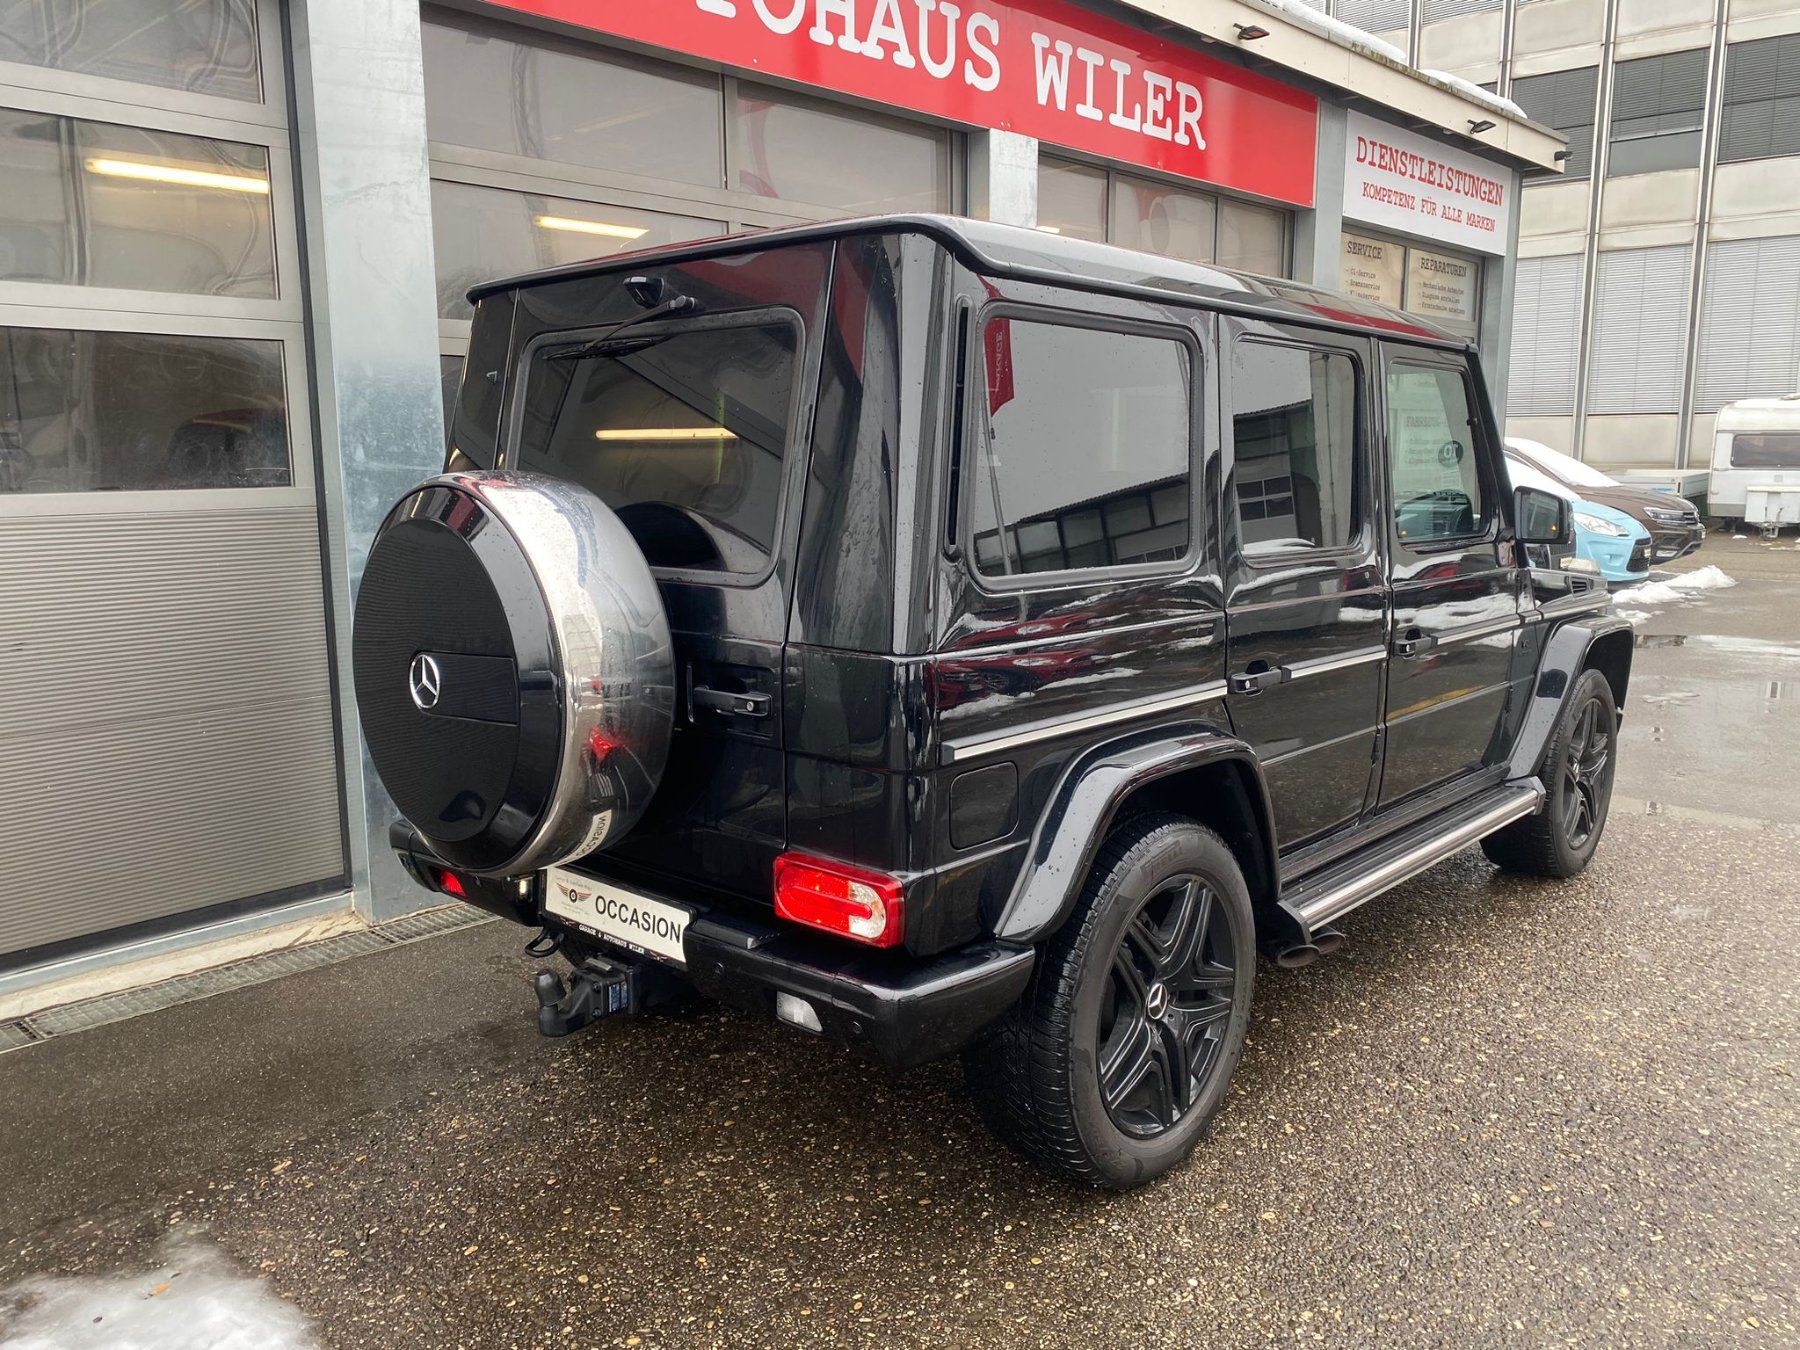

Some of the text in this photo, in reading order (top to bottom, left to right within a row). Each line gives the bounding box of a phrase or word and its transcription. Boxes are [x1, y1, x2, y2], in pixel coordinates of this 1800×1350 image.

[696, 0, 1207, 151] HAUS WILER
[1356, 136, 1504, 207] DIENSTLEISTUNGEN
[1362, 181, 1496, 232] KOMPETENZ FÜR ALLE MARKEN
[1346, 240, 1383, 260] SERVICE
[1420, 256, 1467, 278] REPARATUREN
[595, 895, 681, 944] OCCASION
